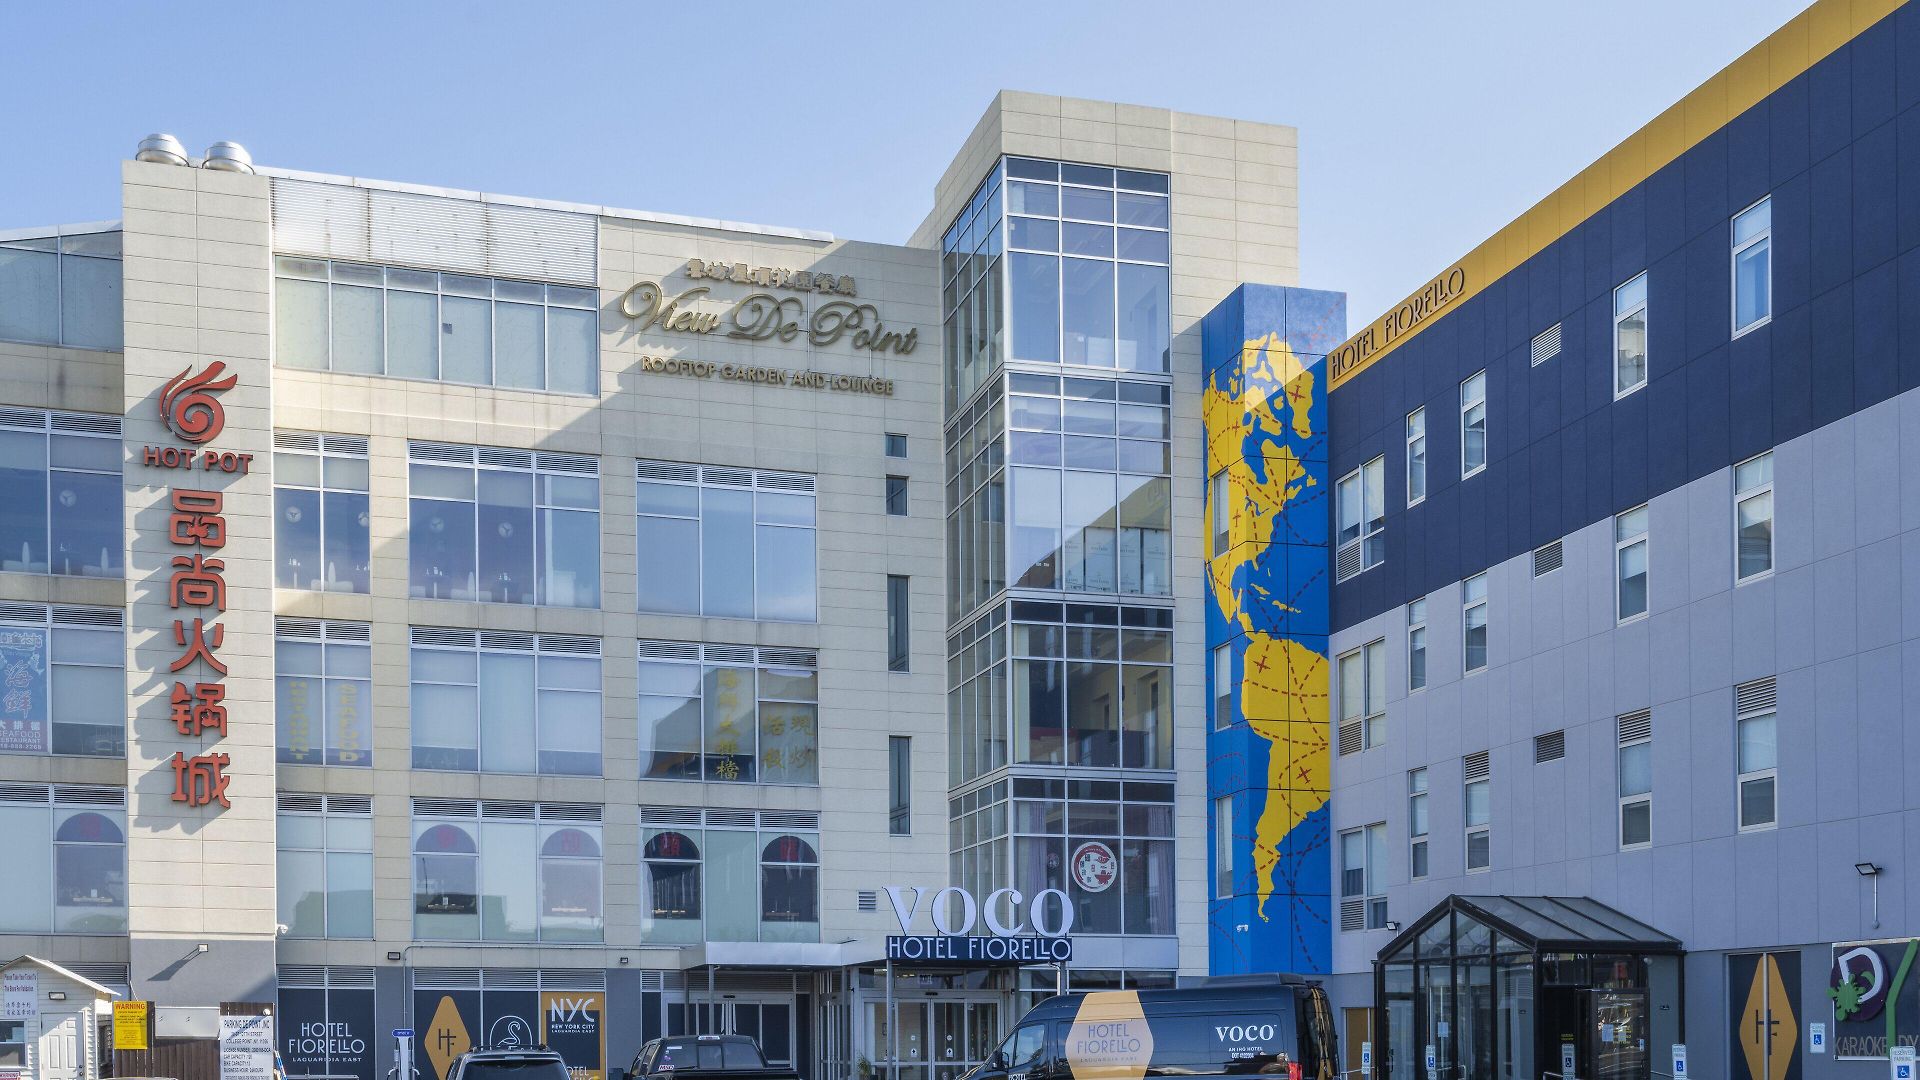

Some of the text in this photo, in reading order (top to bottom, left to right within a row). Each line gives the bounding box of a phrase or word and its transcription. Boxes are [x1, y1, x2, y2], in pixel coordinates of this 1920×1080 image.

[619, 280, 918, 354] View De Point
[1332, 267, 1465, 380] HOTEL FIORELLO
[641, 355, 894, 395] ROOFTOP GARDEN AND LOUNGE
[143, 445, 254, 475] HOT POT
[888, 937, 1072, 961] HOTEL FIORELLO
[551, 998, 595, 1022] NYC
[301, 1022, 352, 1037] HOTEL
[1088, 1023, 1129, 1038] HOTEL
[289, 1038, 365, 1054] FIORELLO
[1076, 1038, 1141, 1054] FIORELLO
[1835, 1036, 1888, 1057] KARAOKE
[567, 1066, 590, 1076] OTEL
